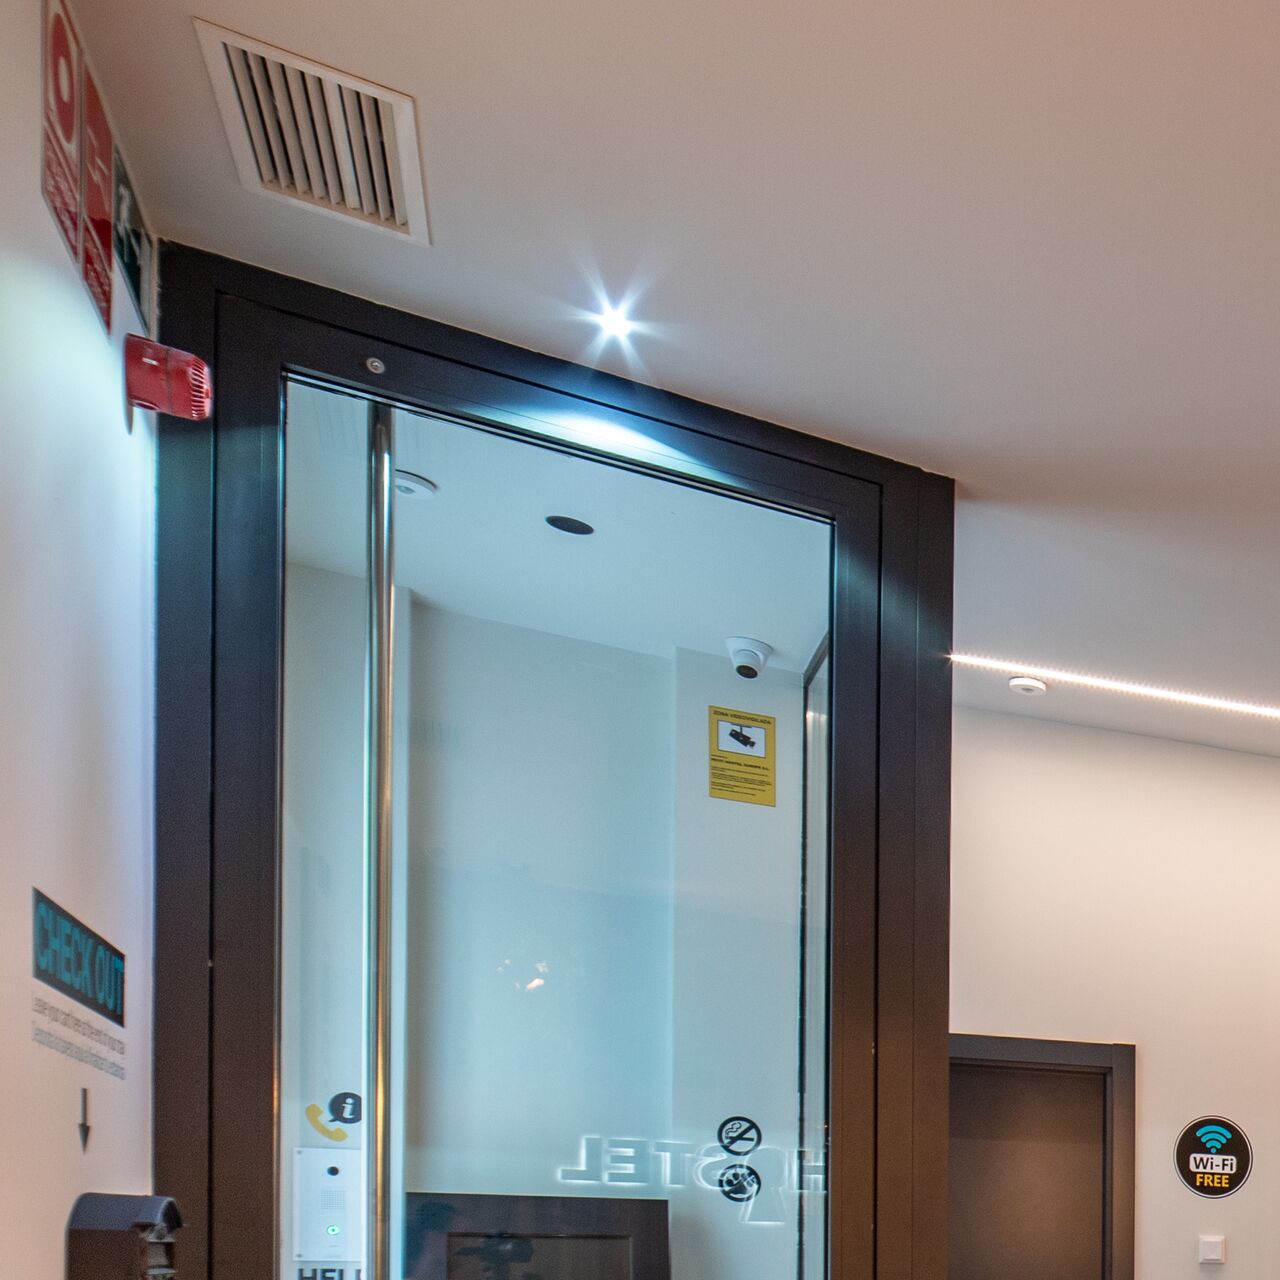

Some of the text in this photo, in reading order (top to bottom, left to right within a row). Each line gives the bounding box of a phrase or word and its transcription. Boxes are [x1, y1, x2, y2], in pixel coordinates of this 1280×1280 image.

[37, 902, 124, 1015] CHECK OUT
[1193, 1156, 1233, 1171] Wi-Fi
[1196, 1173, 1229, 1187] FREE
